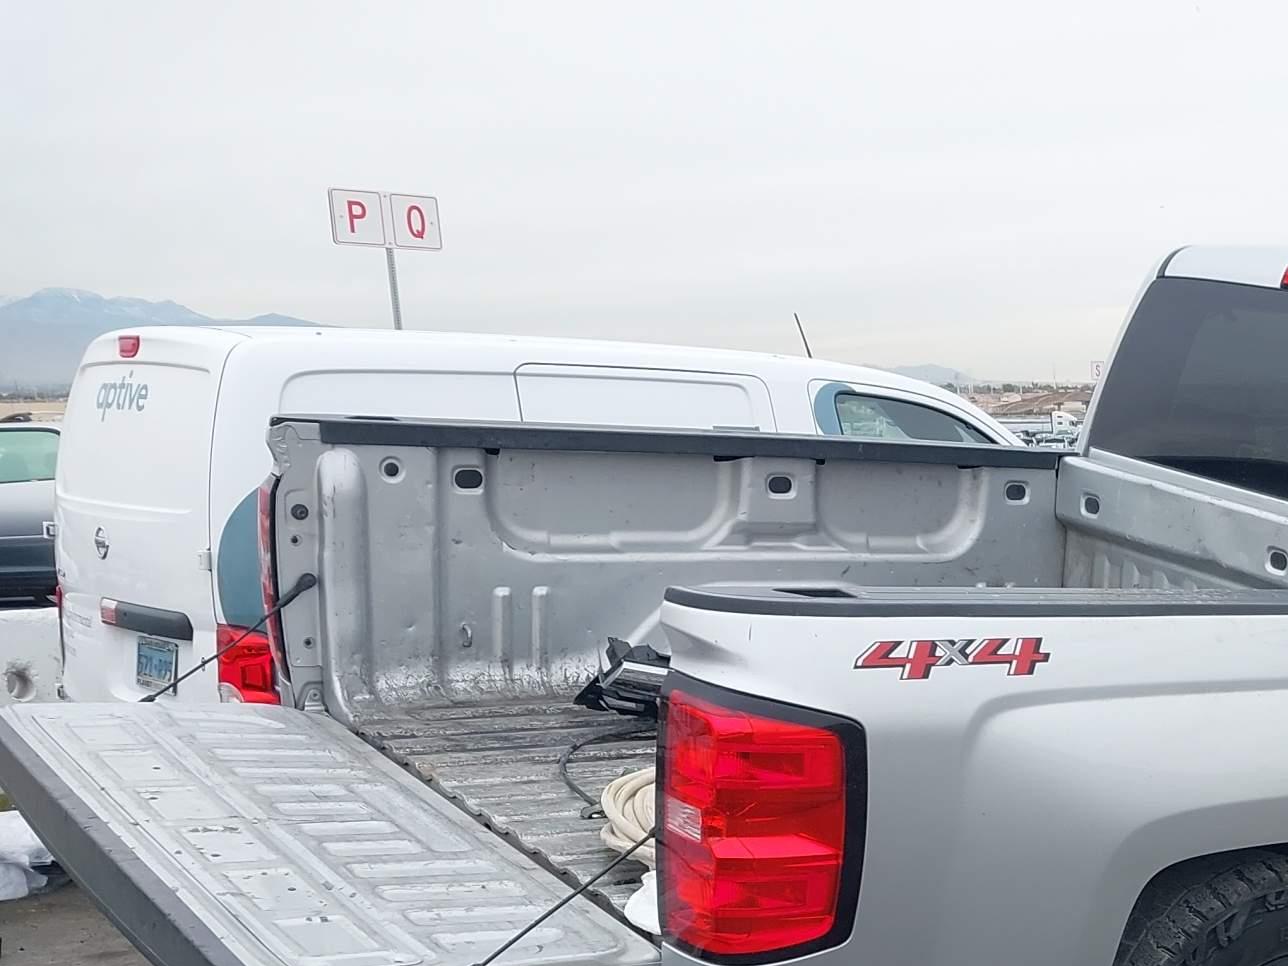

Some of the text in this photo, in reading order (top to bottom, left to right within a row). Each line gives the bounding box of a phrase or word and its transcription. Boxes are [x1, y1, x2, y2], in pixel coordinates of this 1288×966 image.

[347, 200, 366, 233] P
[407, 205, 426, 239] Q
[1095, 364, 1101, 377] S
[96, 369, 149, 422] aptive
